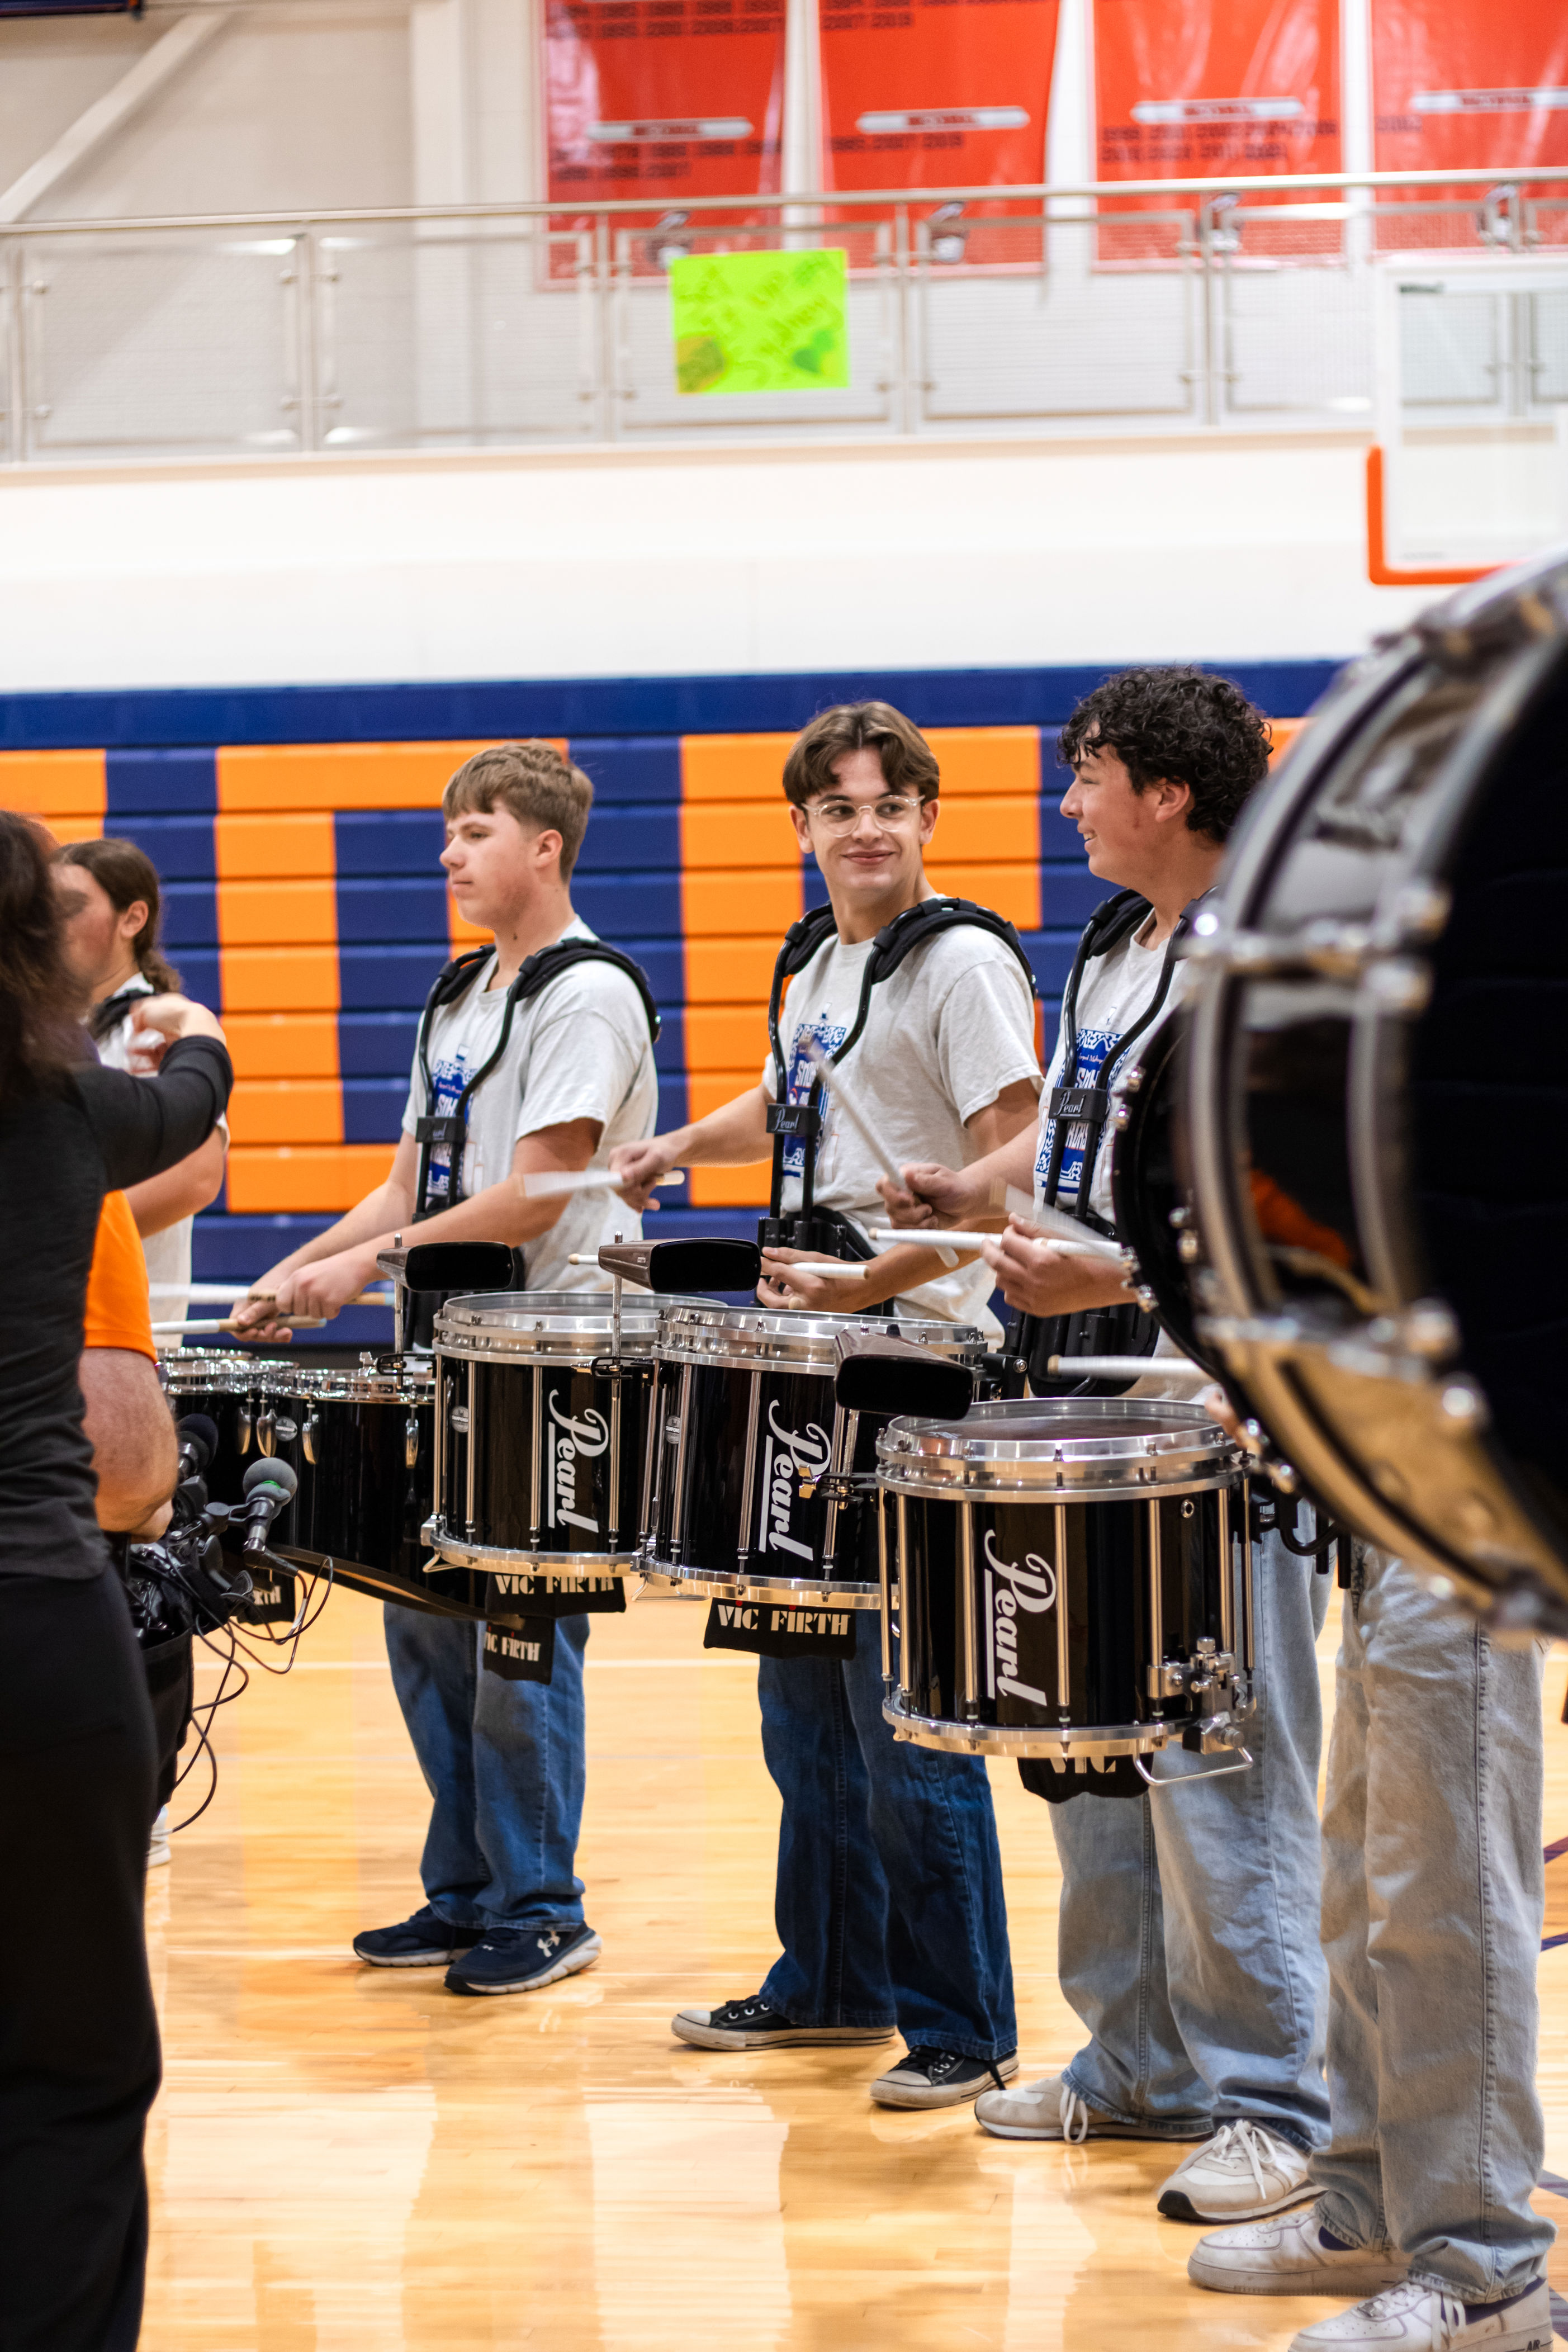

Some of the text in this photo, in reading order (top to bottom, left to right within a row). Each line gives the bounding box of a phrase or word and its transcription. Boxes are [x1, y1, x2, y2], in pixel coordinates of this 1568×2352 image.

[1053, 1090, 1086, 1116] Pearl
[774, 1106, 800, 1131] Pearl
[549, 1389, 609, 1534] Pearl
[767, 1399, 831, 1561] Pearl
[495, 1574, 614, 1594] VIC FIRTH
[717, 1604, 849, 1635] VIC FIRTH
[984, 1529, 1057, 1706] Pearl
[501, 1636, 541, 1662] FIRTH
[1527, 2339, 1541, 2351] AIR
